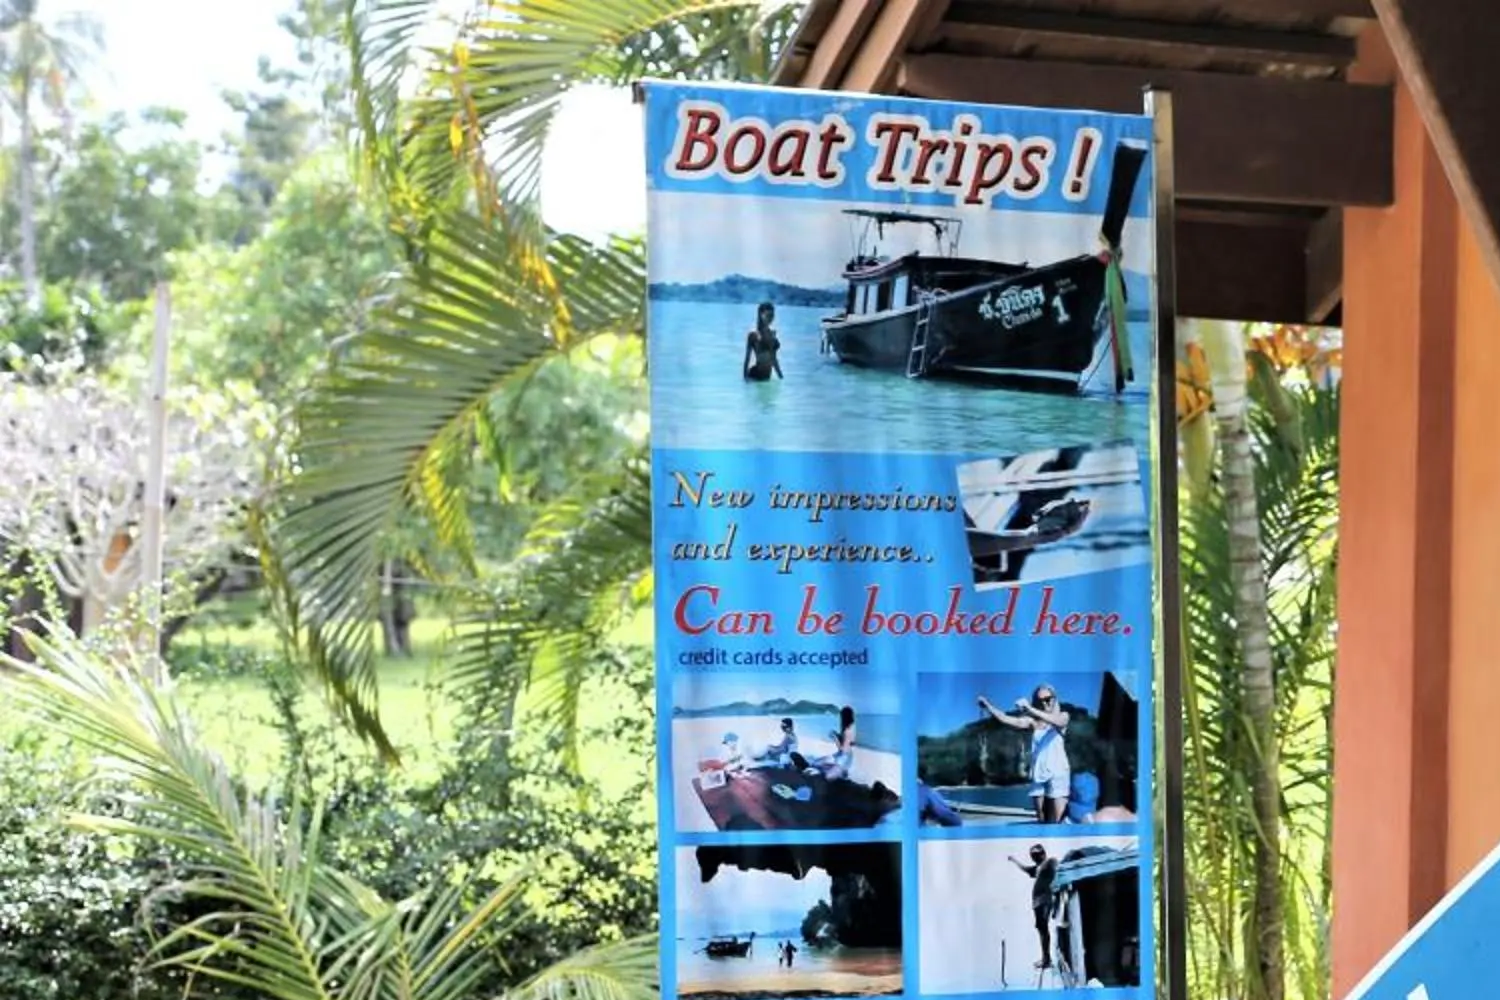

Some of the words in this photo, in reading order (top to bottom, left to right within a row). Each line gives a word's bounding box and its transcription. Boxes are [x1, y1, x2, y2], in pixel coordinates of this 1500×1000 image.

[674, 109, 846, 180] Boat
[873, 121, 1049, 205] Trips
[1070, 135, 1095, 193] !
[669, 470, 755, 510] New
[768, 483, 958, 523] impressions
[671, 524, 737, 562] and
[672, 585, 774, 637] Can
[798, 585, 843, 635] be
[861, 585, 1018, 636] booked
[1031, 585, 1134, 637] here.
[678, 648, 729, 666] credit
[732, 648, 784, 666] cards
[787, 648, 869, 669] accepted
